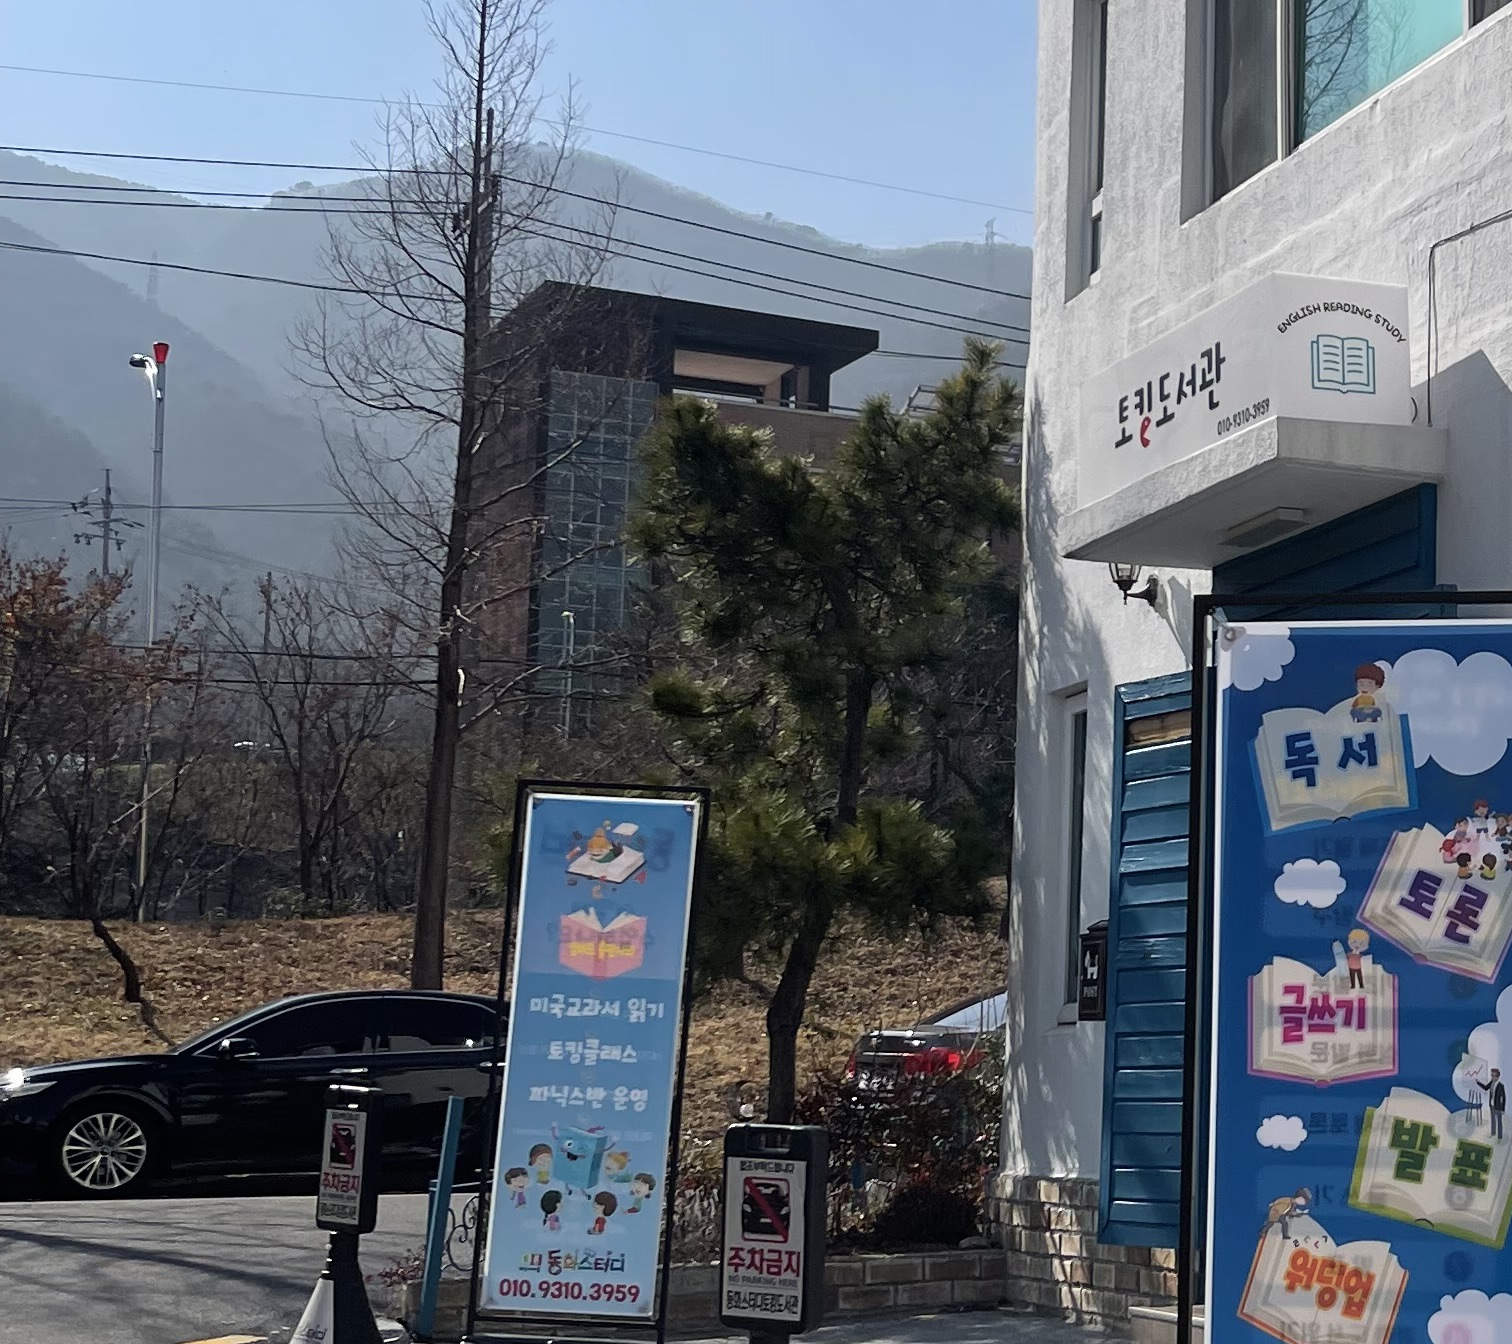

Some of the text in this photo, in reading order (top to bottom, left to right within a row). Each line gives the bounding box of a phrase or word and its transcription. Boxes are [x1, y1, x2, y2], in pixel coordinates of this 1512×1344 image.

[1277, 302, 1407, 343] ENGLISH READING STUDY
[1115, 341, 1226, 448] 토킹도서관
[1217, 397, 1270, 436] 010-9310-3959
[1399, 867, 1490, 945] 토론
[529, 994, 664, 1023] 미국교과서 읽기
[1278, 983, 1367, 1044] 글쓰기
[547, 1038, 638, 1066] 토킹클래스
[613, 1086, 649, 1112] 운영
[547, 1248, 626, 1276] 동화스터디
[727, 1246, 801, 1278] 주차금지
[499, 1278, 641, 1303] 010.9310.3959
[1282, 1245, 1377, 1320] 워딩업
